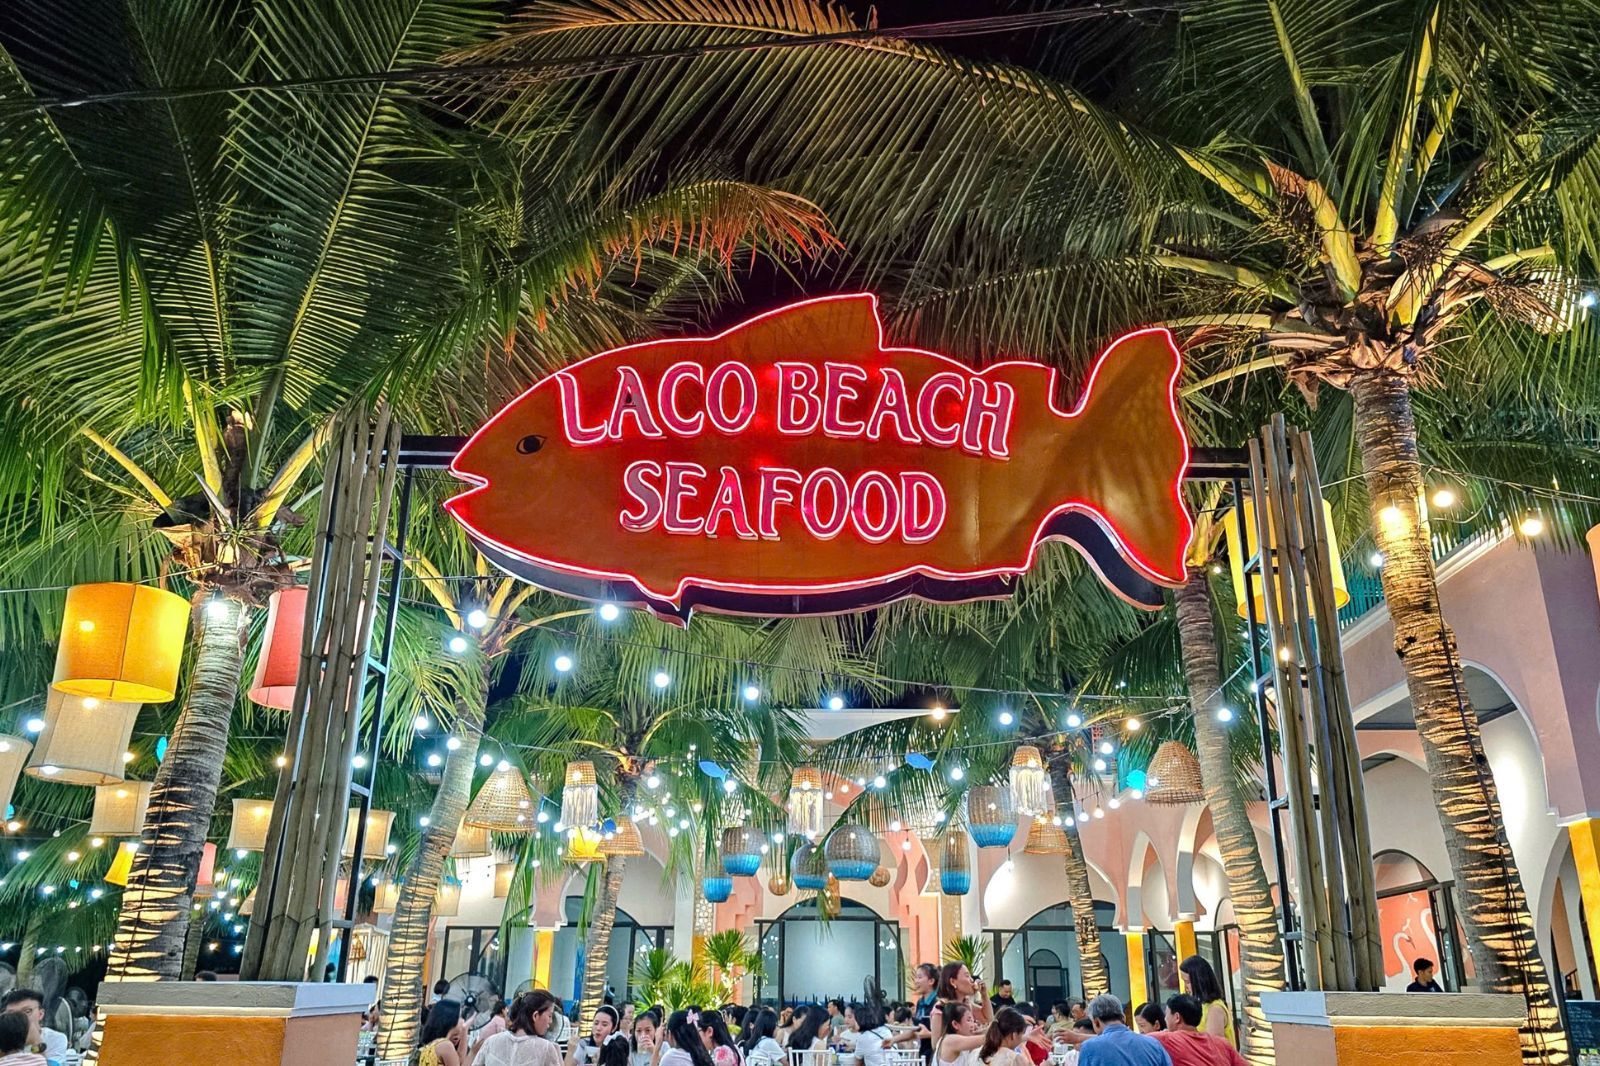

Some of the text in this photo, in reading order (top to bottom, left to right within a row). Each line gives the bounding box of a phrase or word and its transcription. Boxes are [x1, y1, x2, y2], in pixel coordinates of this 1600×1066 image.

[555, 361, 1014, 459] LACO BEACH
[620, 460, 946, 544] SEAFOOD
